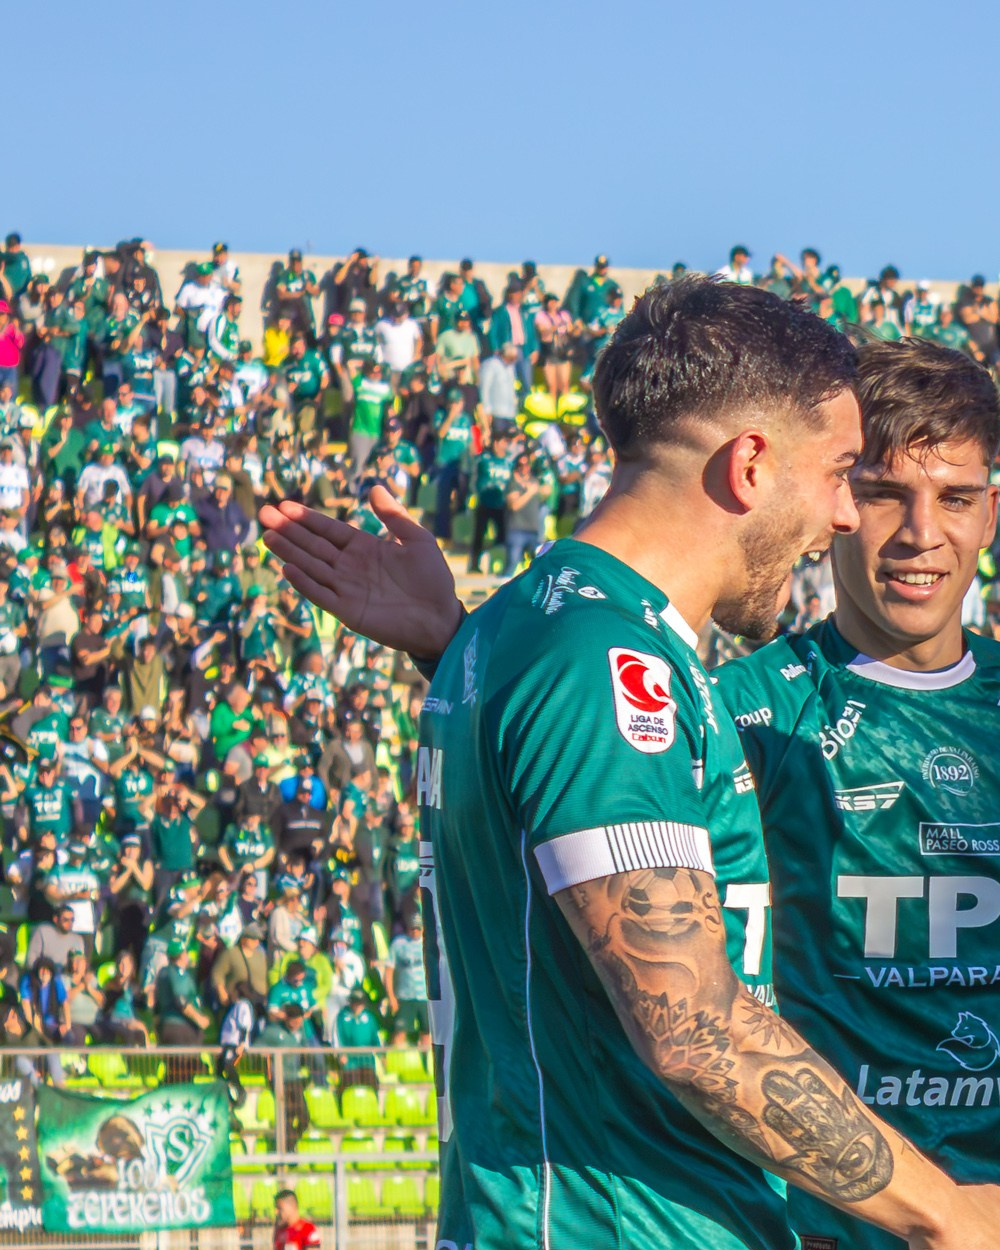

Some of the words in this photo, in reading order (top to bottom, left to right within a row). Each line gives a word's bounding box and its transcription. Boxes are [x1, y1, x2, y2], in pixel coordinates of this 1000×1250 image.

[630, 714, 652, 724] LIGA
[653, 716, 664, 726] DE
[627, 724, 668, 735] ASCENSO
[932, 764, 969, 781] 1892
[926, 827, 964, 840] MALL
[926, 838, 968, 851] PASEO
[971, 838, 1000, 851] ROSS
